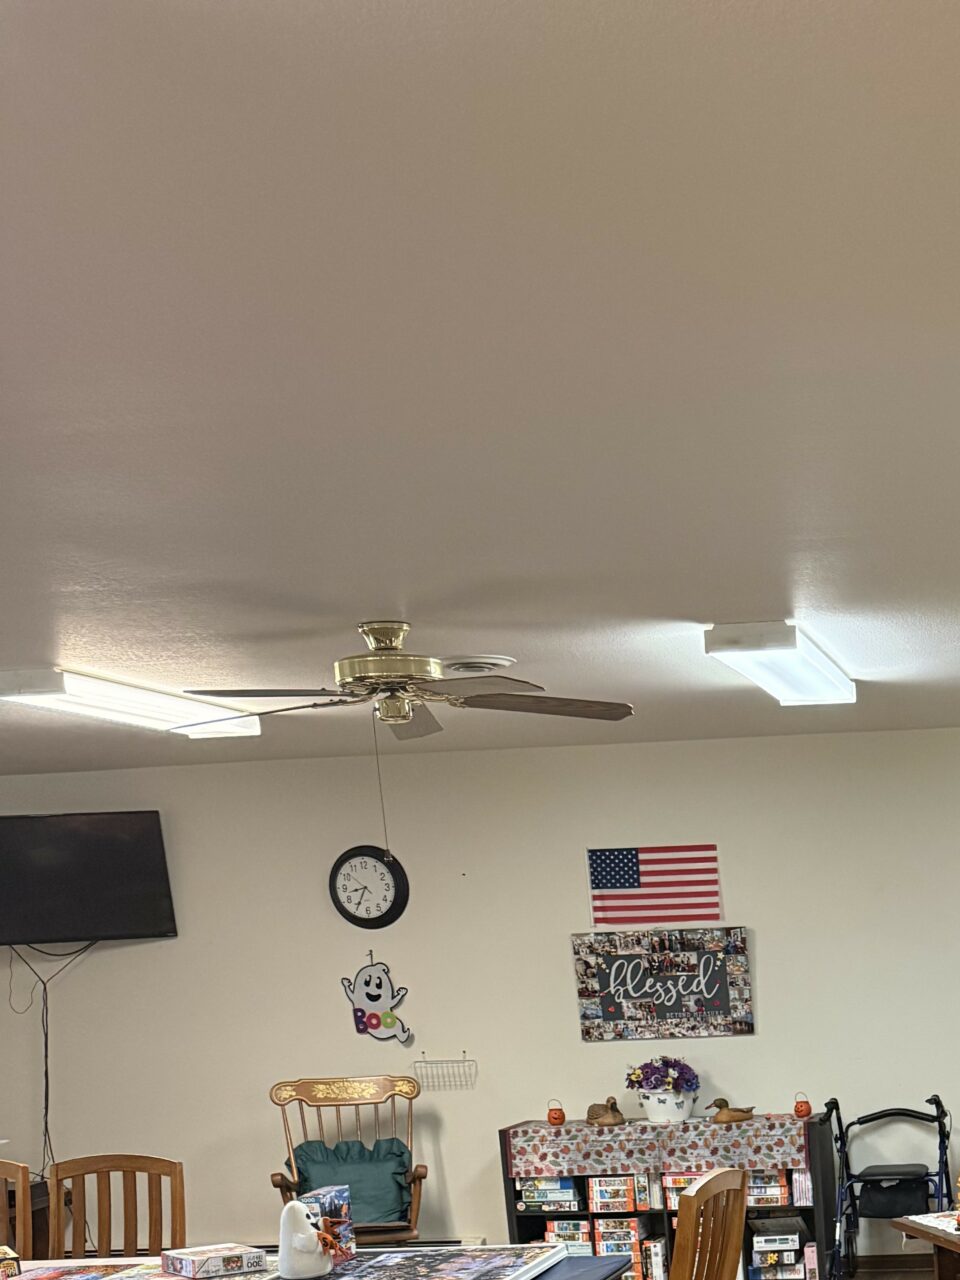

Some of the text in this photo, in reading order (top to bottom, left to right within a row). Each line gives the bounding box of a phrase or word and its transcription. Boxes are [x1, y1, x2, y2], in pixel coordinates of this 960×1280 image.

[604, 954, 720, 1006] blessed
[353, 1007, 397, 1035] BOO
[247, 1260, 263, 1269] 300
